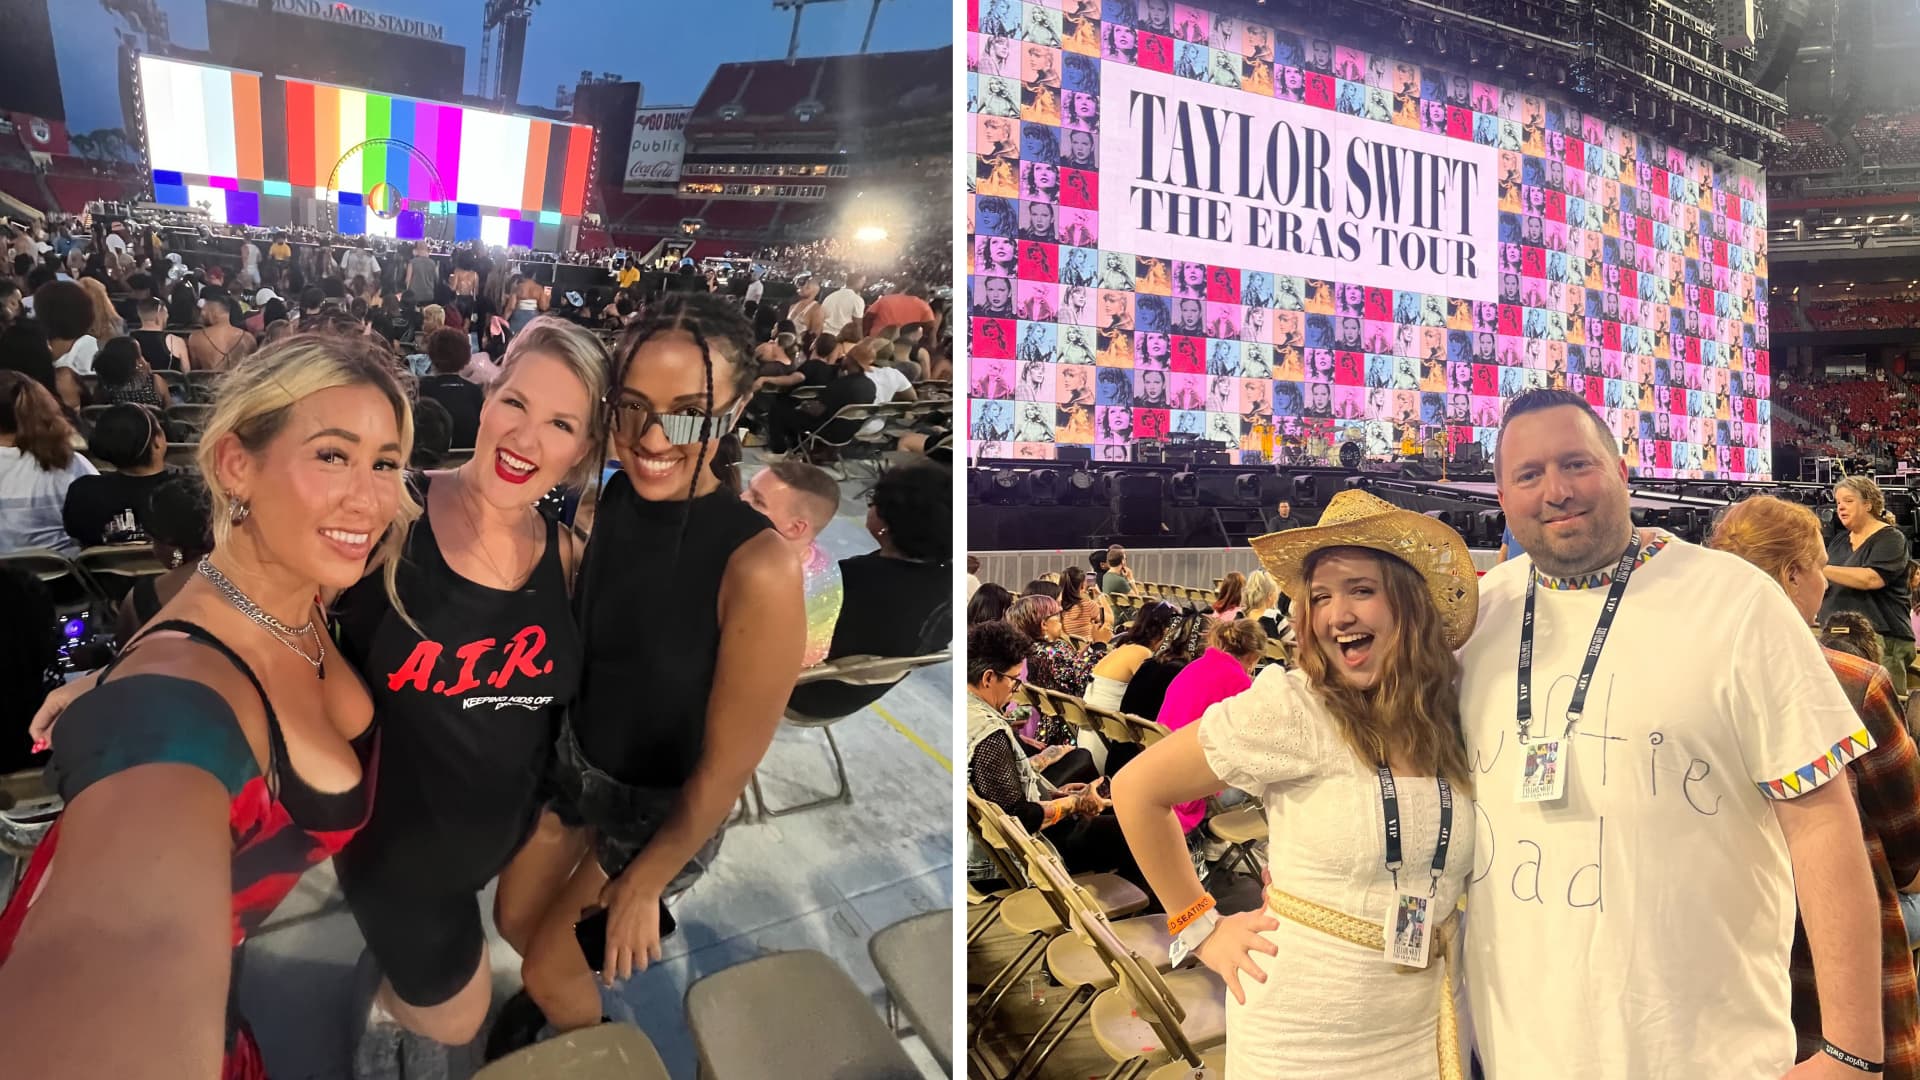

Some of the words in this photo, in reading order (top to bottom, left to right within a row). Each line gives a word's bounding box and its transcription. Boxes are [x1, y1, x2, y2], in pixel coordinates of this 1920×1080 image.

[322, 2, 376, 27] JAMES
[378, 15, 443, 40] STADIUM
[648, 113, 663, 130] GO
[664, 112, 686, 130] BUC
[632, 140, 680, 153] Publix
[1129, 90, 1333, 213] TAYLOR
[1346, 136, 1478, 236] SWIFT
[1130, 186, 1233, 243] THE
[1245, 205, 1361, 262] ERAS
[1372, 226, 1479, 279] TOUR
[1606, 597, 1617, 612] VIP
[387, 625, 554, 696] A.I.R.
[1578, 673, 1590, 691] VIP
[1519, 683, 1528, 700] VIP
[463, 695, 508, 710] KEEPING
[508, 696, 534, 704] KIDS
[533, 696, 554, 705] OFF
[1388, 818, 1398, 838] VIP
[1440, 827, 1450, 846] VIP
[1177, 898, 1209, 925] SEATING
[1825, 1044, 1845, 1060] Swift
[1844, 1055, 1869, 1070] Taylor
